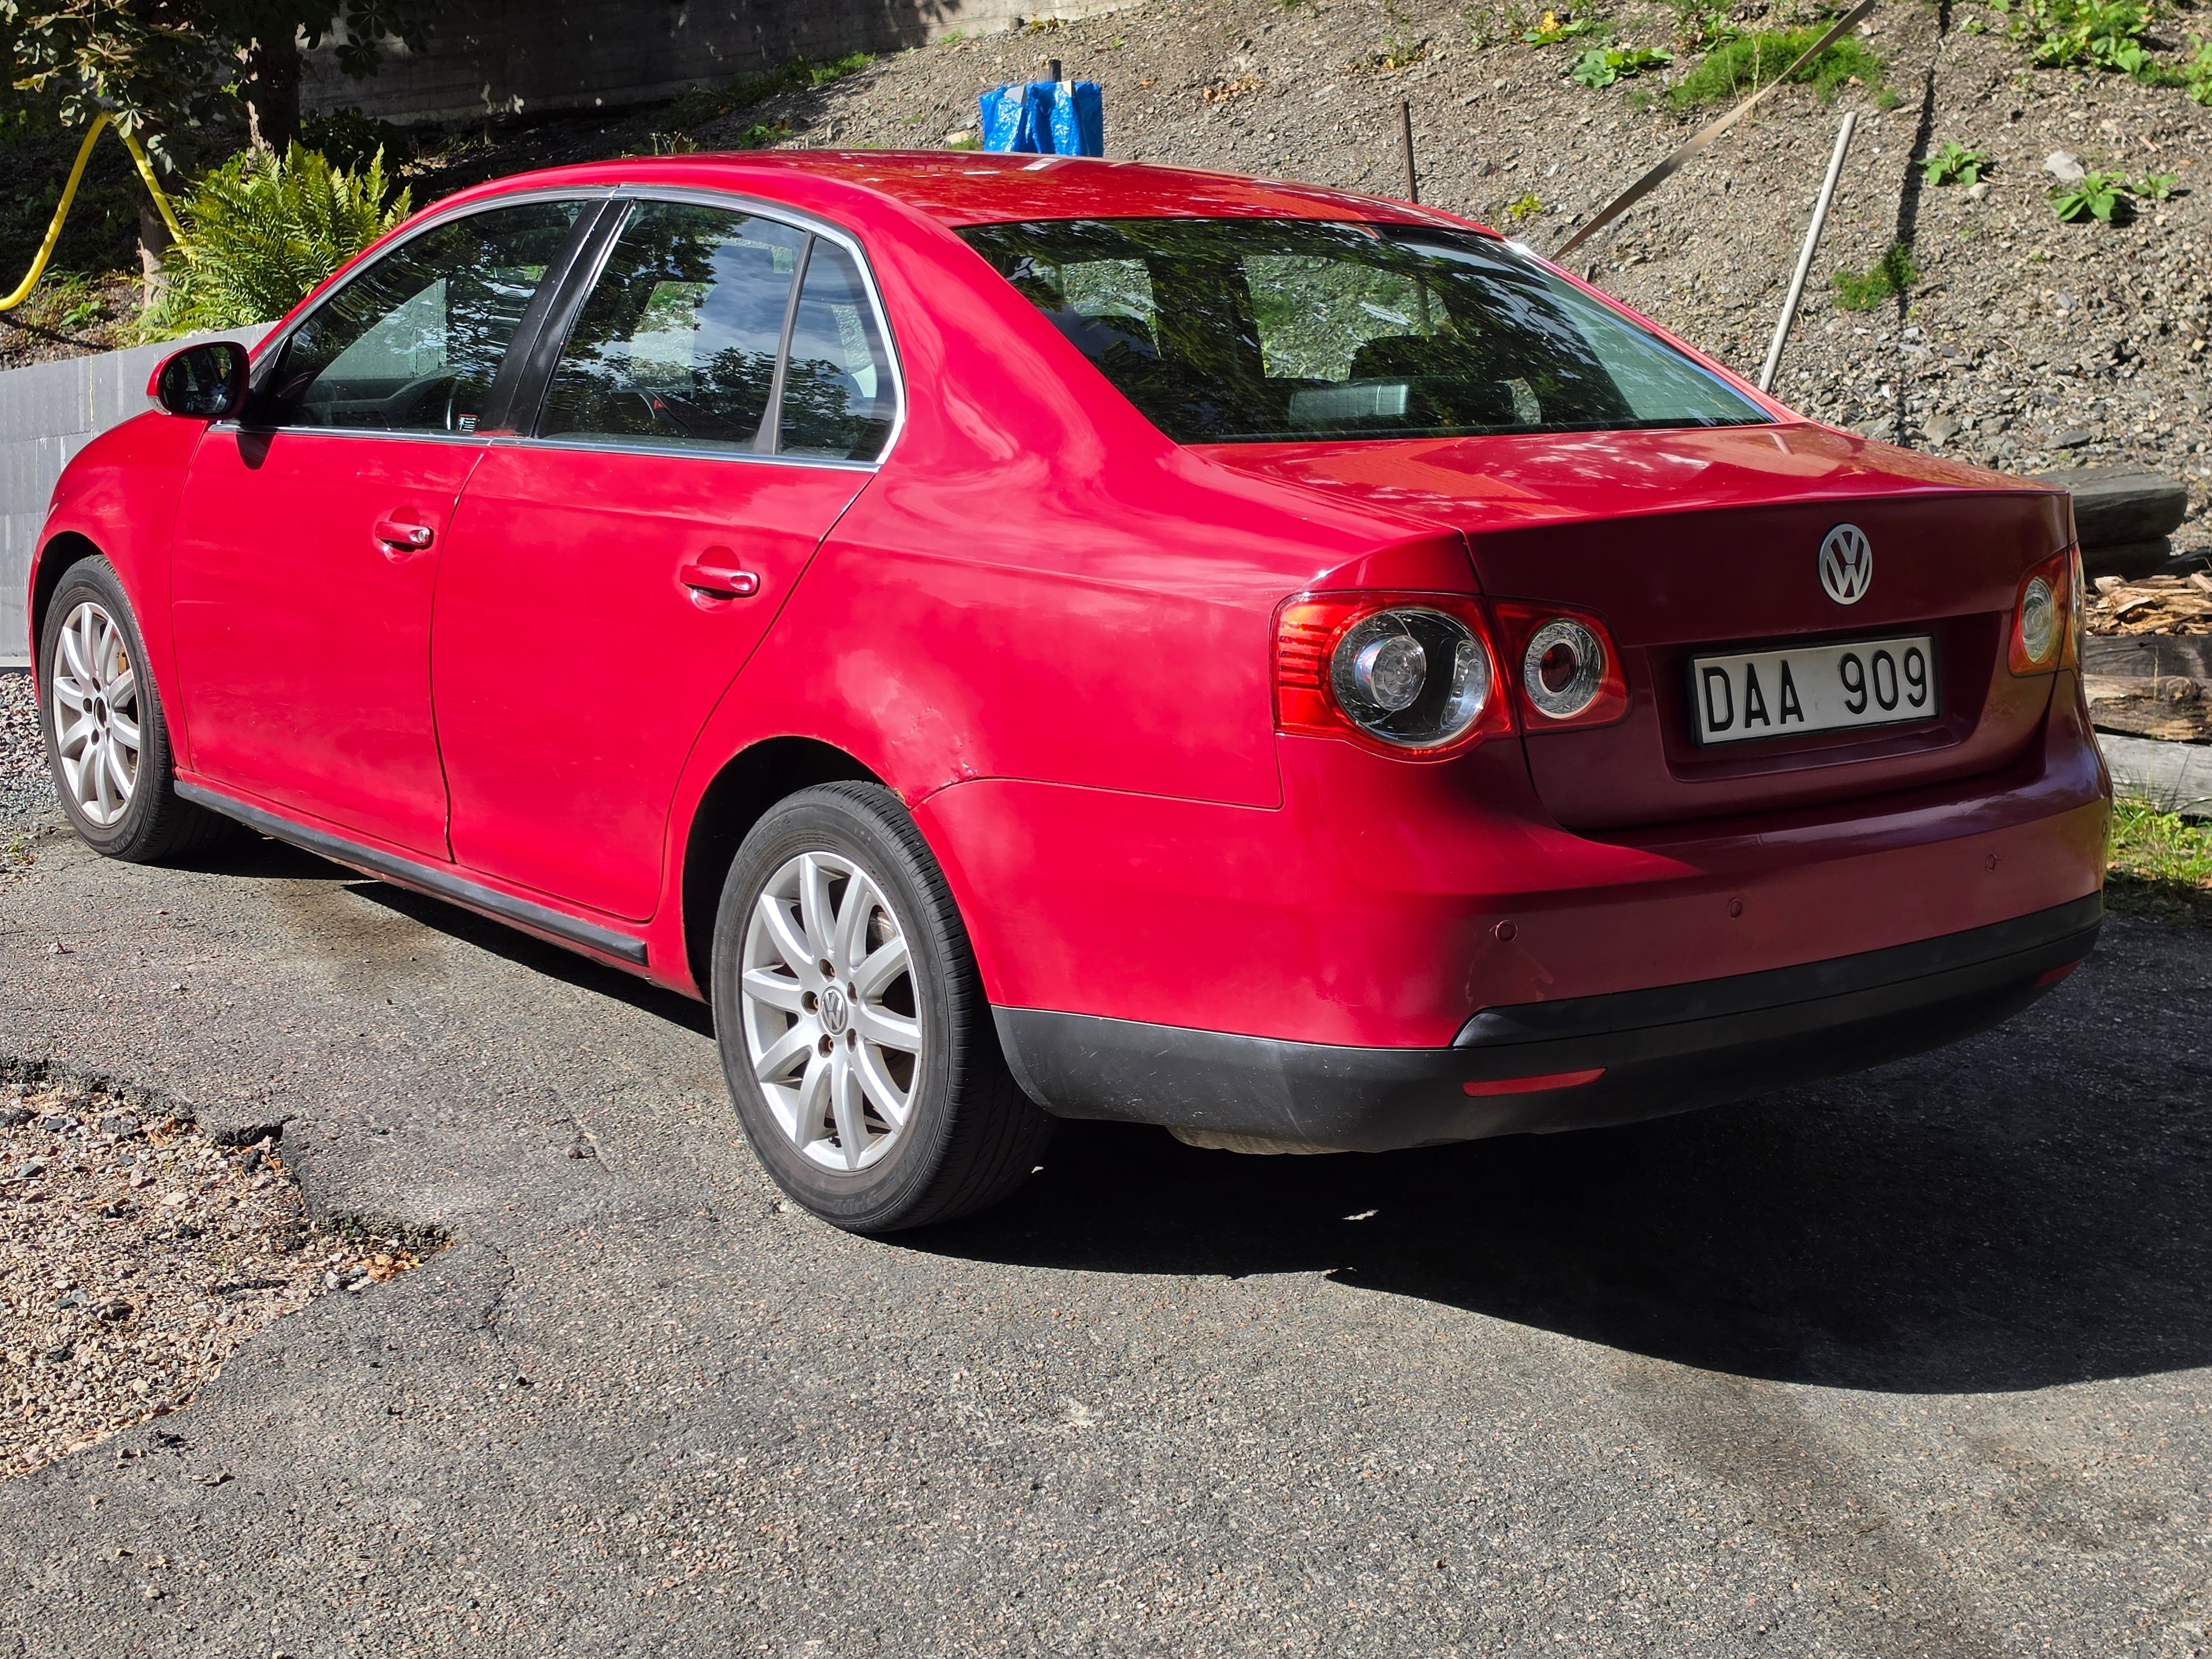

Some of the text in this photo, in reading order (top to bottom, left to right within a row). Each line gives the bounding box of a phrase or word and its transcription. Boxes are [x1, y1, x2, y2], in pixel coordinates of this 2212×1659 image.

[1820, 525, 1872, 603] VW
[1702, 646, 1927, 733] DAA 909
[822, 989, 847, 1033] VW
